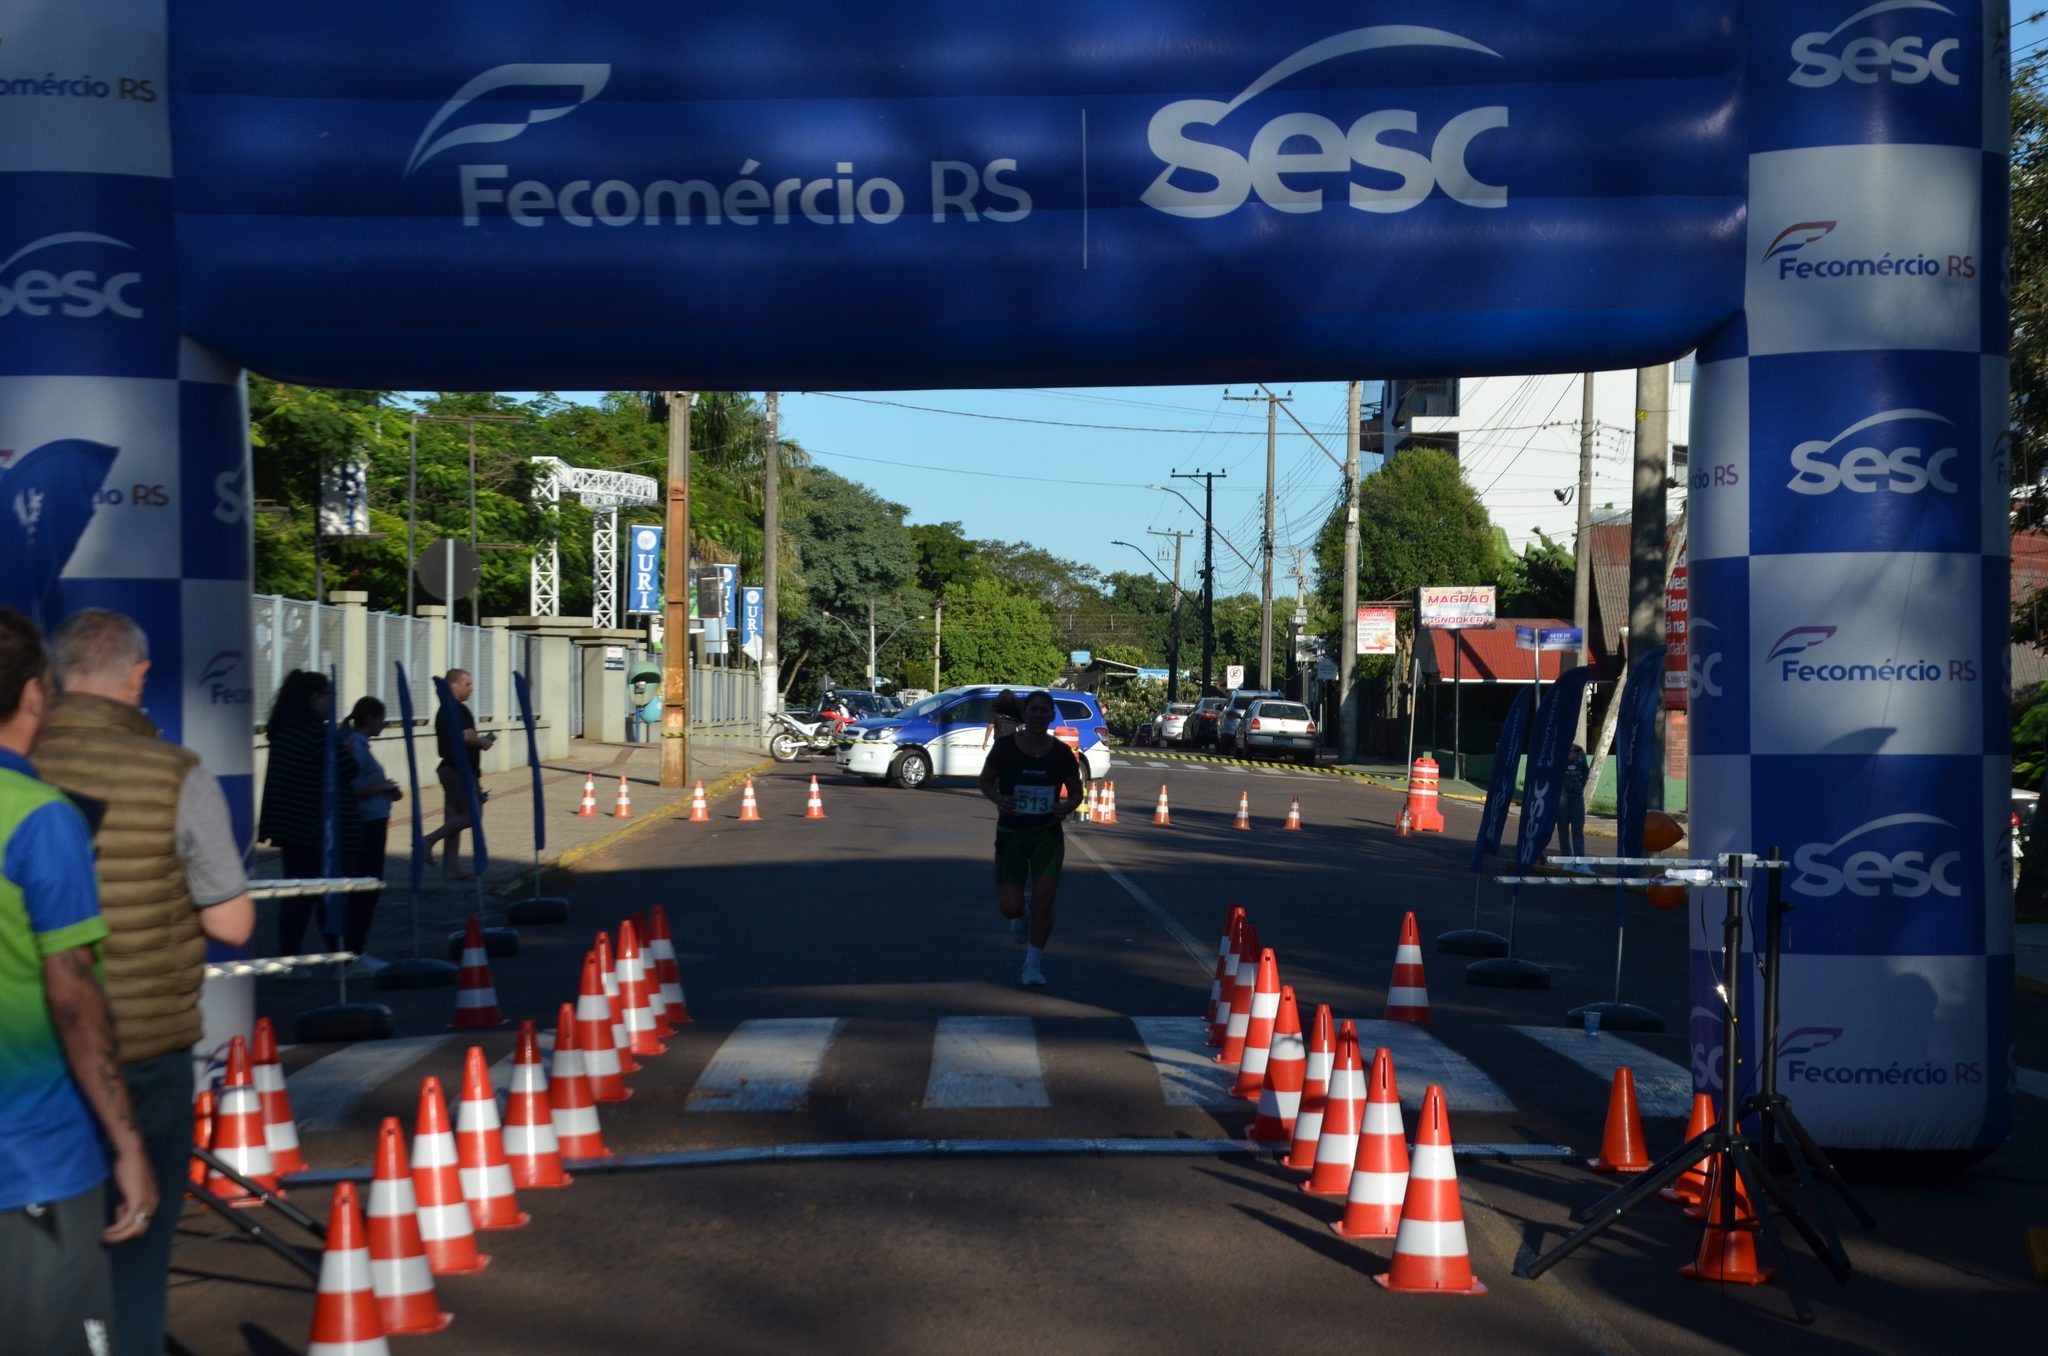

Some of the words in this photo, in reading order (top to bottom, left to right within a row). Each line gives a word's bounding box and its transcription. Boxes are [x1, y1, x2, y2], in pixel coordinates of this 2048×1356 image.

[118, 77, 157, 102] RS
[460, 158, 905, 227] Fecomércio
[930, 158, 1032, 224] RS
[1779, 252, 1940, 280] Fecomércio
[1947, 254, 1976, 279] RS
[1713, 463, 1739, 487] RS
[131, 484, 170, 507] RS
[637, 554, 655, 609] URI
[1433, 616, 1484, 624] SNOOKER
[1782, 658, 1941, 682] Fecomércio
[1948, 659, 1978, 682] RS
[1018, 794, 1049, 812] 513
[1788, 1060, 1948, 1085] Fecomércio
[1954, 1061, 1983, 1085] RS
